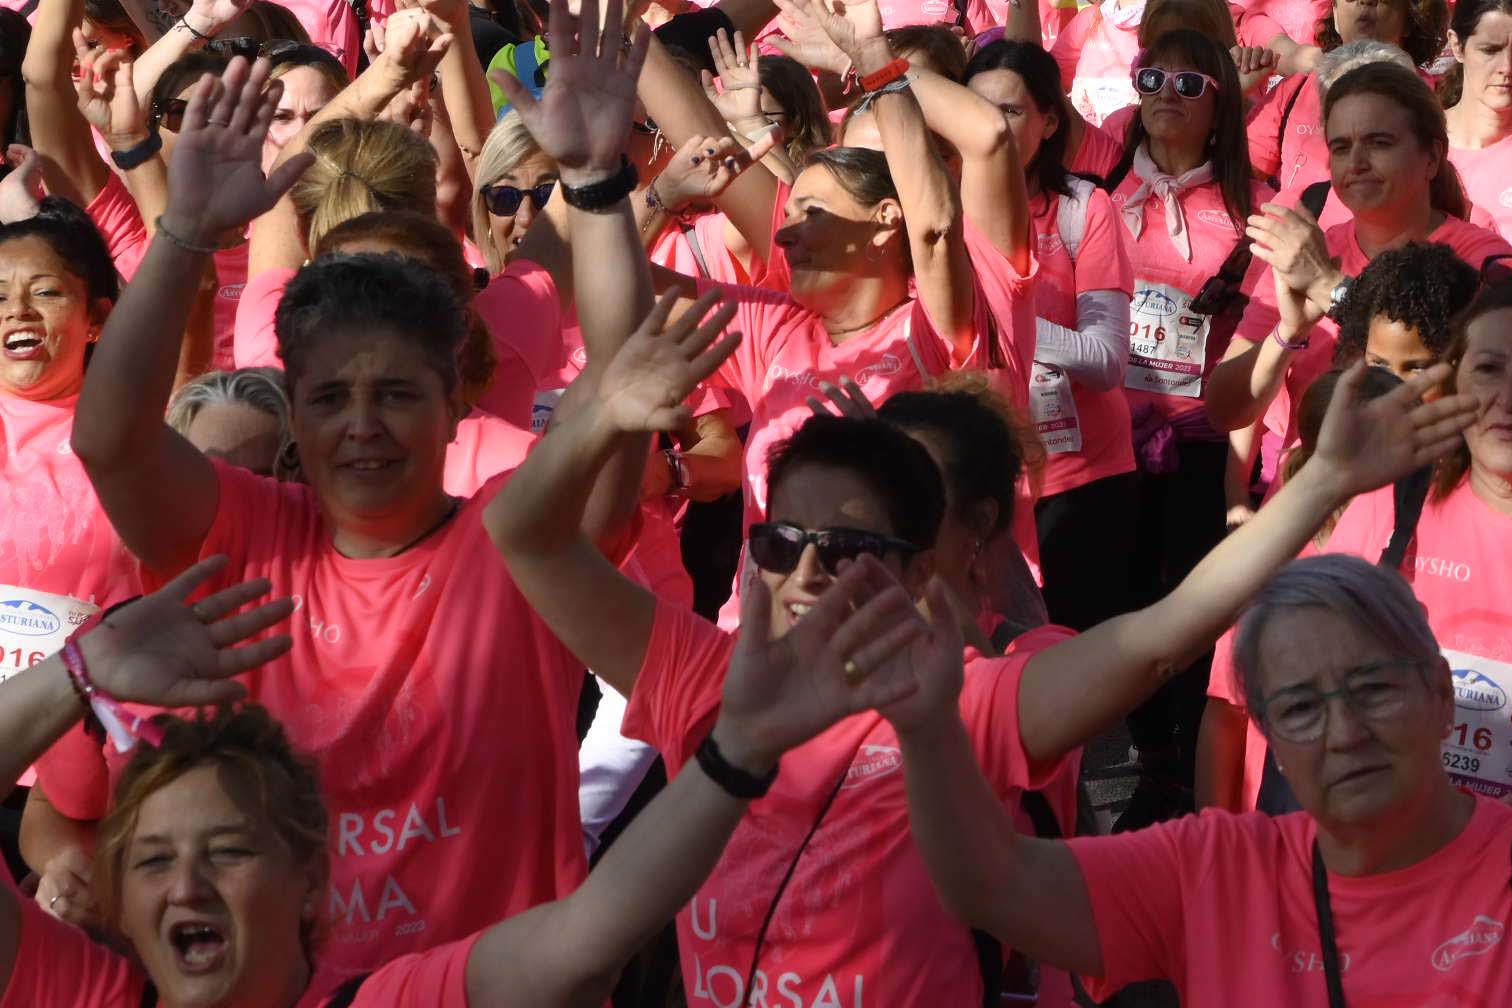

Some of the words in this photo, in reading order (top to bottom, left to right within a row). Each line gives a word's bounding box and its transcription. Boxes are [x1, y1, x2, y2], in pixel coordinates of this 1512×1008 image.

[1149, 360, 1174, 370] MUJER
[0, 612, 54, 631] STURIANA
[338, 795, 462, 857] RSAL
